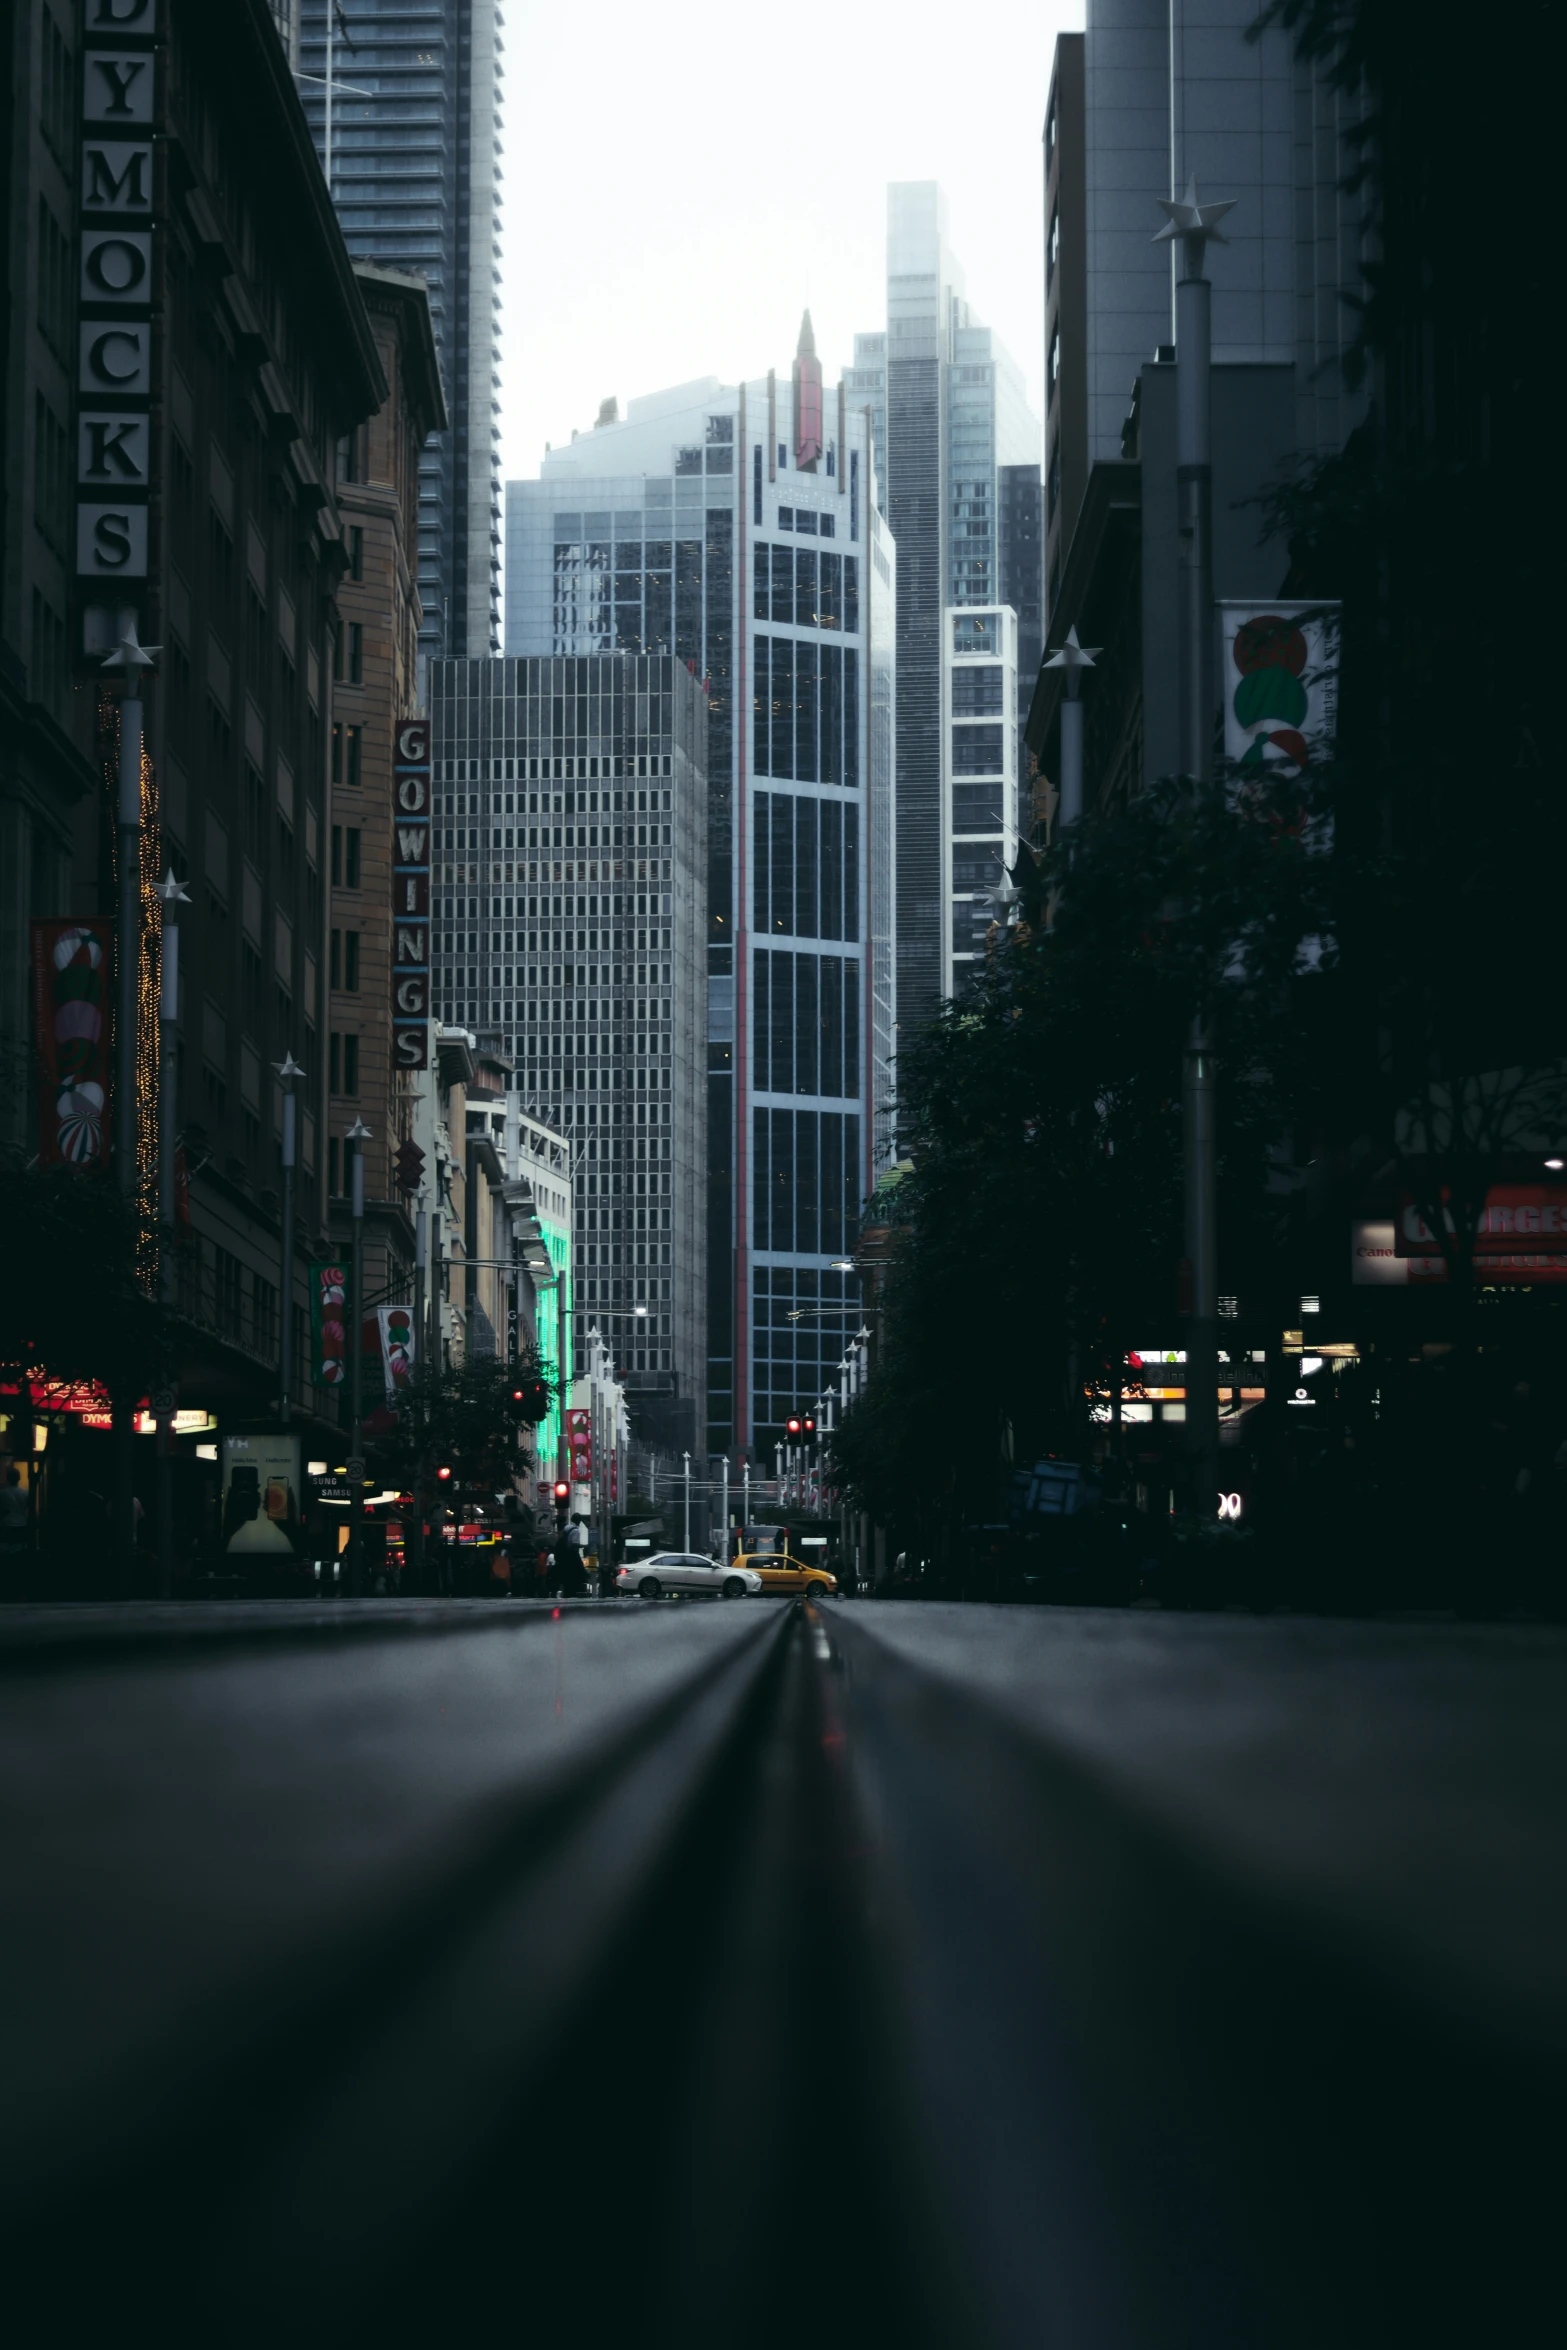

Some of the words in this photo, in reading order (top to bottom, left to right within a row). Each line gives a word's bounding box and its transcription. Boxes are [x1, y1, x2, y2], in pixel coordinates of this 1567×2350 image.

[398, 726, 426, 1065] GOWINGS
[35, 930, 45, 959] merry
[35, 963, 46, 1013] christmas
[1356, 1246, 1395, 1258] Cano
[507, 1310, 517, 1365] GALE
[155, 1394, 172, 1407] 20
[350, 1466, 362, 1475] 20
